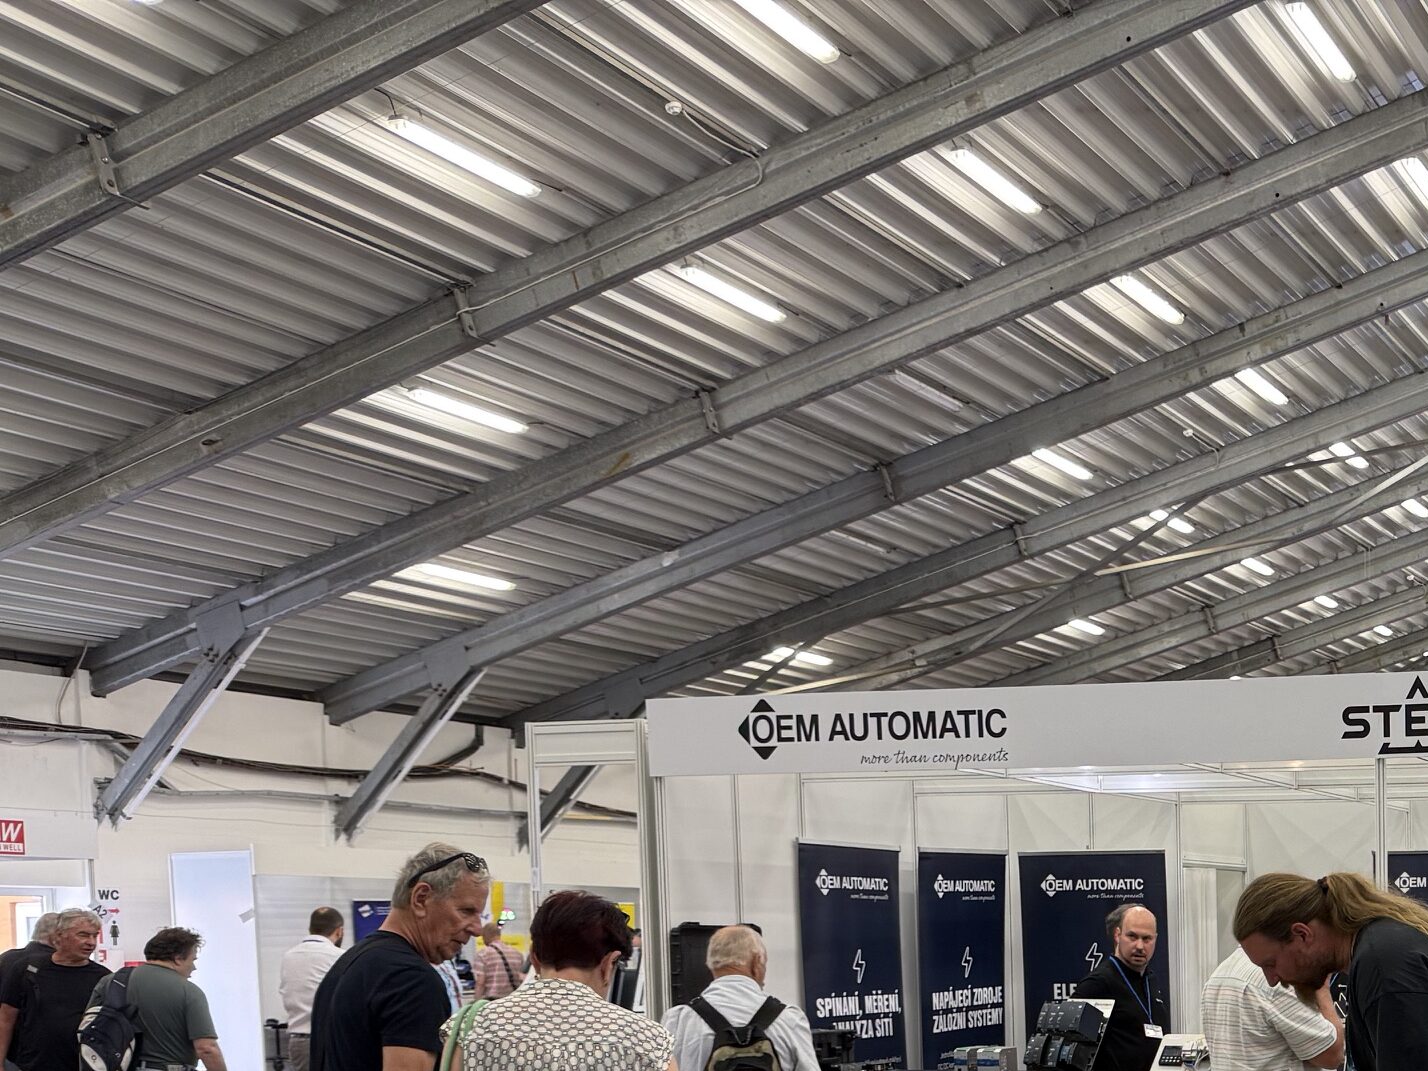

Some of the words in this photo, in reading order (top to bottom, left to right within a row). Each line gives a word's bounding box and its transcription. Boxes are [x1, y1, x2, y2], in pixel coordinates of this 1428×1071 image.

[751, 713, 820, 744] OEM
[828, 708, 1008, 742] AUTOMATIC
[860, 753, 892, 765] more
[893, 750, 930, 765] than
[931, 748, 1010, 771] components
[820, 874, 842, 889] OEM
[842, 877, 889, 891] AUTOMATIC
[938, 880, 955, 892] OEM
[954, 880, 996, 892] AUTOMATIC
[1046, 878, 1073, 892] OEM
[1075, 878, 1145, 891] AUTOMATIC
[1400, 877, 1427, 889] OEM
[98, 889, 120, 900] WC
[92, 904, 108, 919] A2
[816, 991, 863, 1018] SPÍNÁNÍ,
[864, 988, 902, 1014] MĚŘENÍ,
[932, 984, 972, 1011] NAPÁJECÍ
[972, 986, 1003, 1006] ZDROJE
[875, 1013, 894, 1038] SÍTÍ
[932, 1005, 967, 1033] ZÁLOŽNÍ
[967, 1006, 1004, 1030] SYSTÉMY
